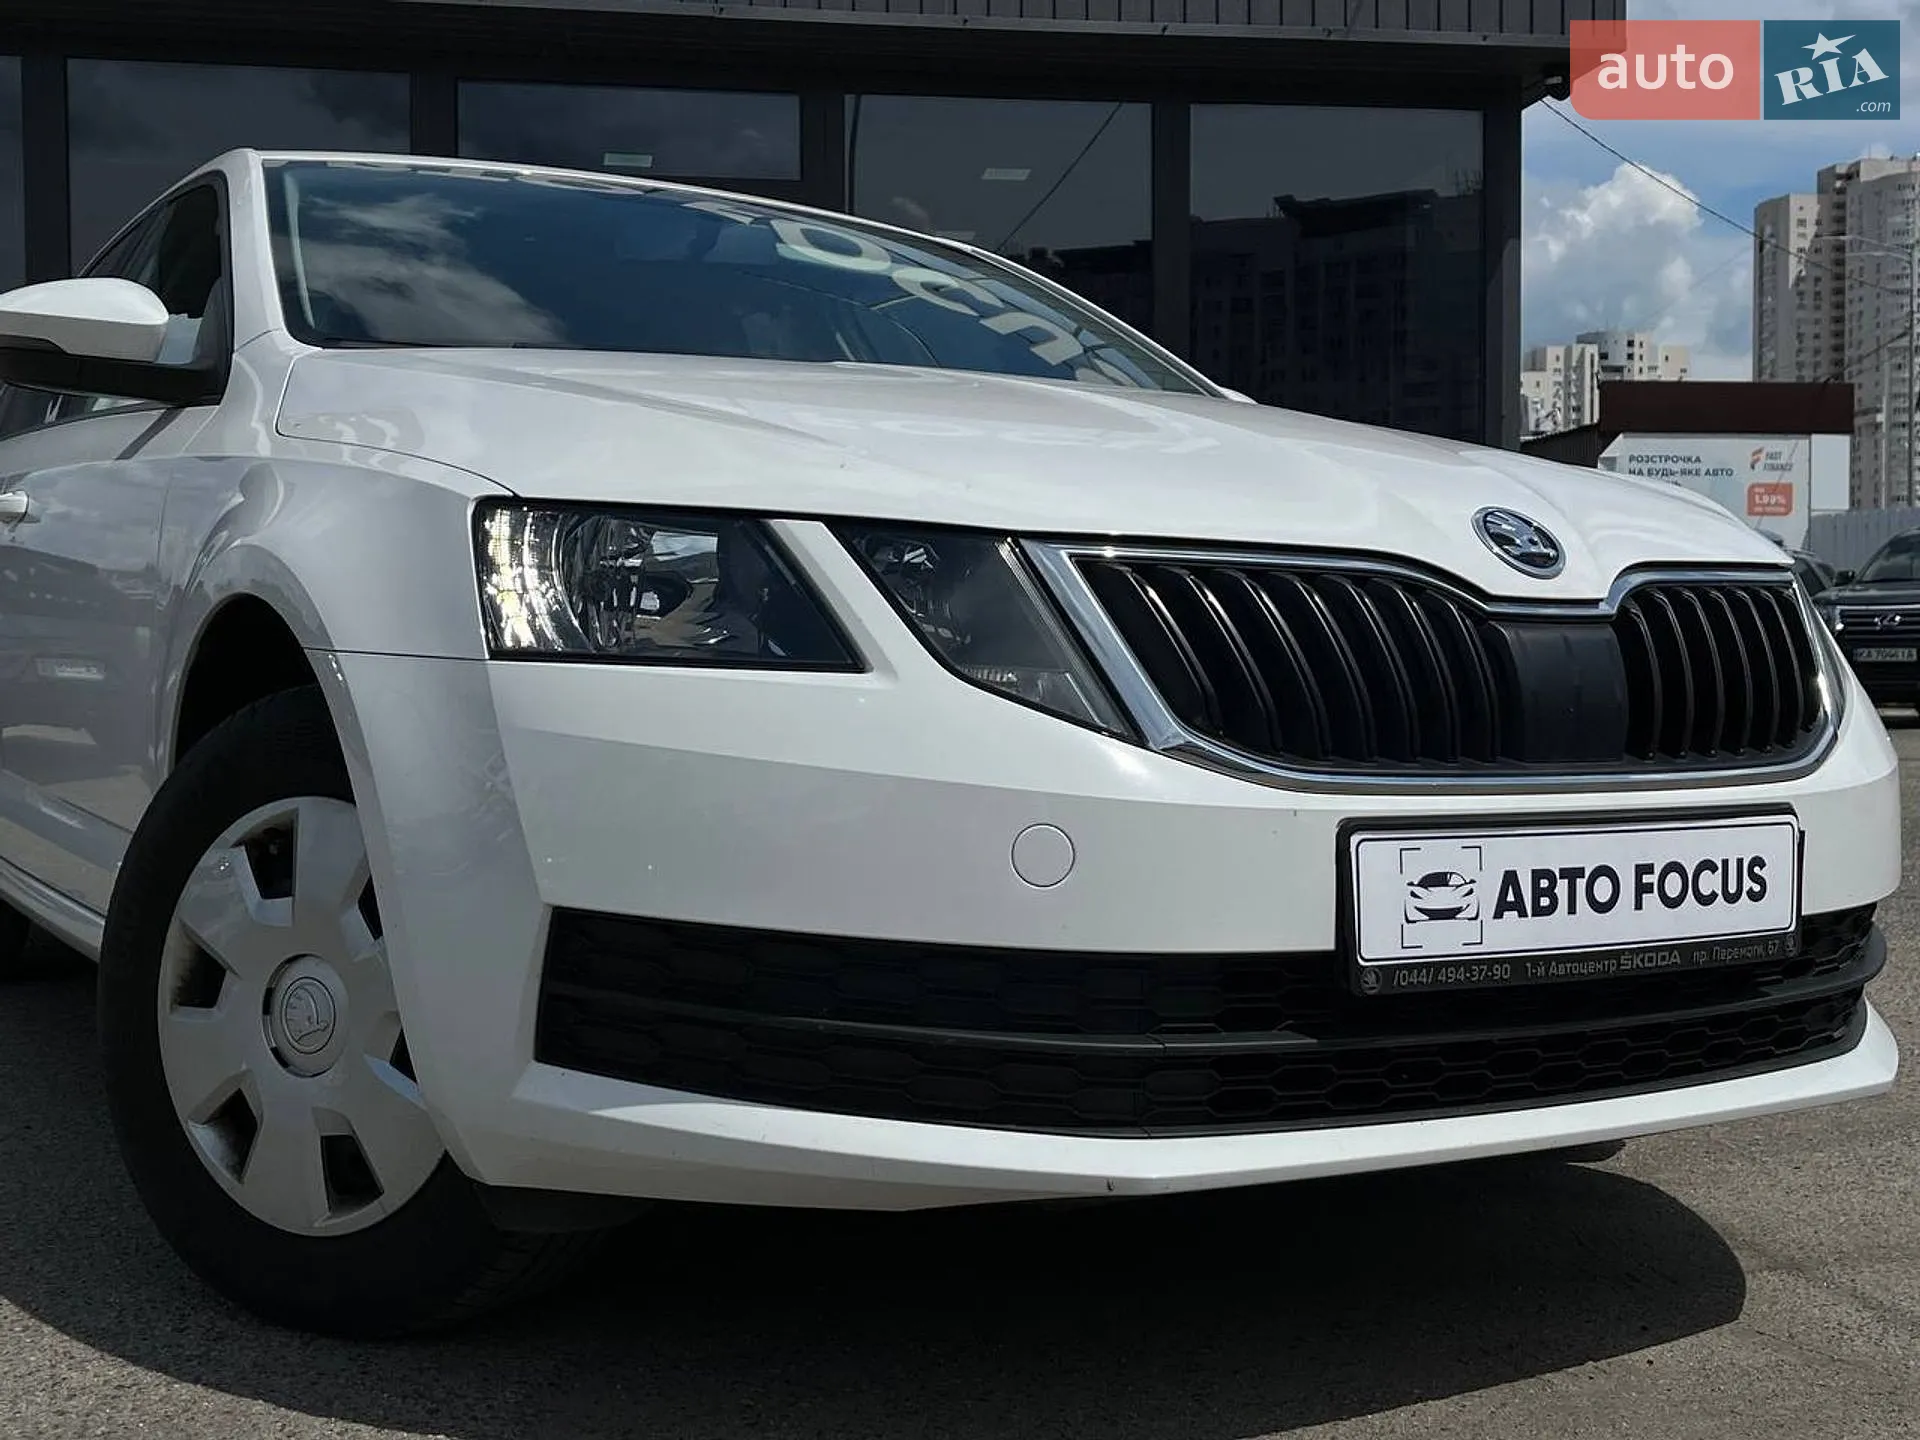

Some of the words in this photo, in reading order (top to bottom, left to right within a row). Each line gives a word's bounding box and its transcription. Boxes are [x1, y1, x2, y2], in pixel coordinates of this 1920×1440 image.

[1628, 454, 1702, 464] РОЗСТРОЧКА
[1628, 467, 1644, 477] НА
[1647, 467, 1701, 478] БУДЬ-ЯКЕ
[1704, 467, 1734, 477] АВТО
[1492, 864, 1621, 920] АВТО
[1634, 855, 1767, 912] FOCUS
[1438, 963, 1511, 983] 494-37-90
[1548, 959, 1617, 977] Автоцентр
[1620, 949, 1681, 970] ŠKODA
